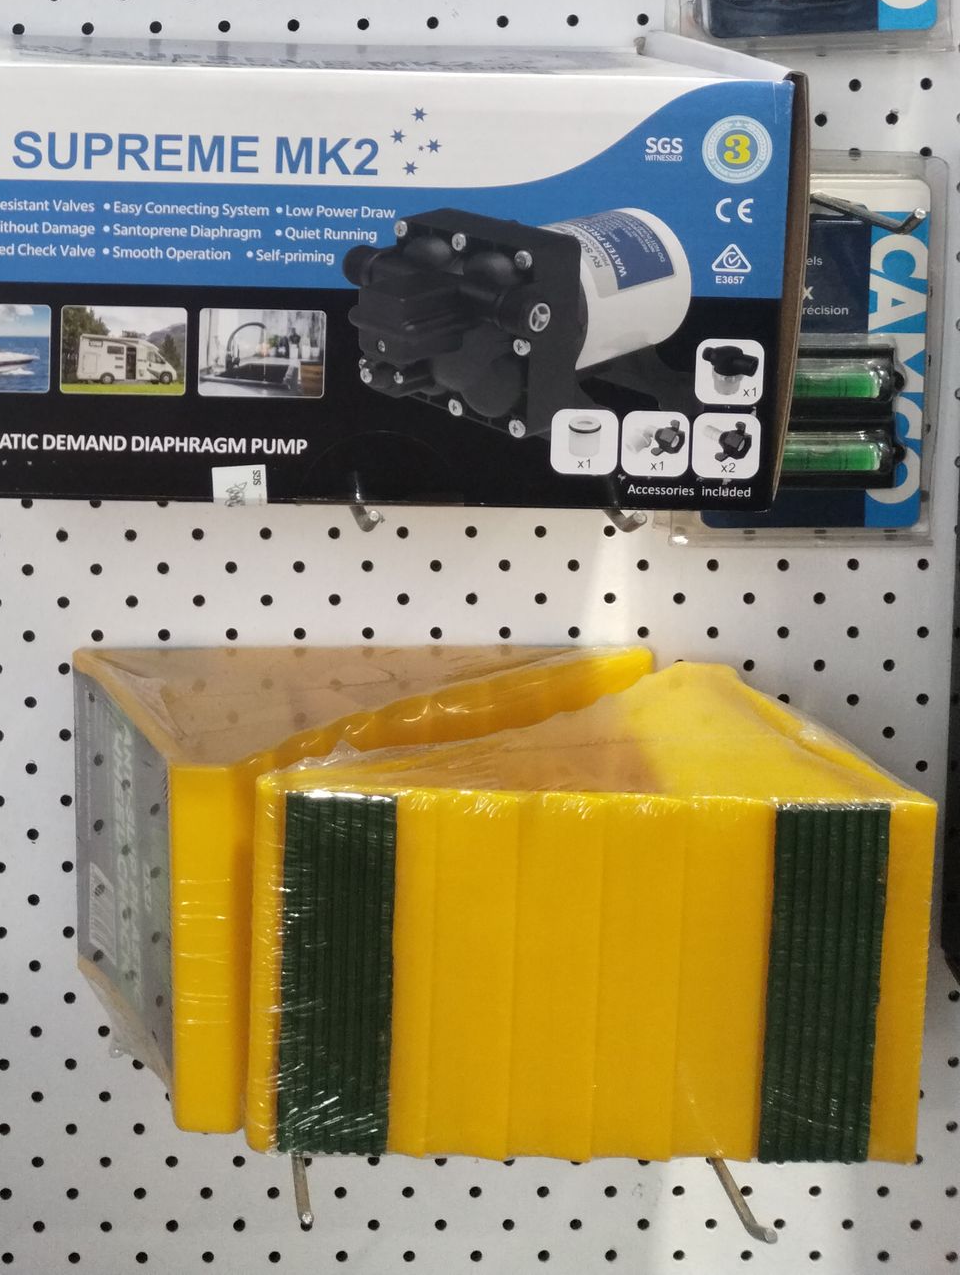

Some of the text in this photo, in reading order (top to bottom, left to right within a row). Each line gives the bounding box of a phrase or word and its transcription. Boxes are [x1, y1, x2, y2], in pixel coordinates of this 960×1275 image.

[13, 131, 259, 173] SUPREME
[276, 137, 378, 175] MK2
[645, 137, 683, 154] SGS
[724, 134, 750, 163] 3
[645, 153, 682, 161] WITNESSED
[53, 200, 94, 212] Valves
[114, 201, 269, 218] Easy Connecting System
[286, 205, 395, 218] Low Power Draw
[716, 198, 753, 223] CE
[42, 222, 95, 237] Damage
[113, 224, 261, 242] Santoprene Diaphragm
[285, 227, 377, 243] Quiet Running
[18, 244, 56, 256] Check
[60, 245, 95, 257] Valve
[113, 246, 230, 262] Smooth Operation
[256, 249, 334, 265] Self-priming
[716, 276, 744, 284] E3657
[802, 305, 848, 315] récision
[744, 387, 756, 396] x1
[43, 434, 127, 451] DEMAND
[132, 436, 246, 453] DIAPHRAGM
[251, 438, 307, 454] PUMP
[578, 459, 590, 468] x1
[651, 461, 663, 470] x1
[721, 463, 735, 473] x2
[253, 470, 261, 485] SGS
[628, 483, 751, 497] Accessories included
